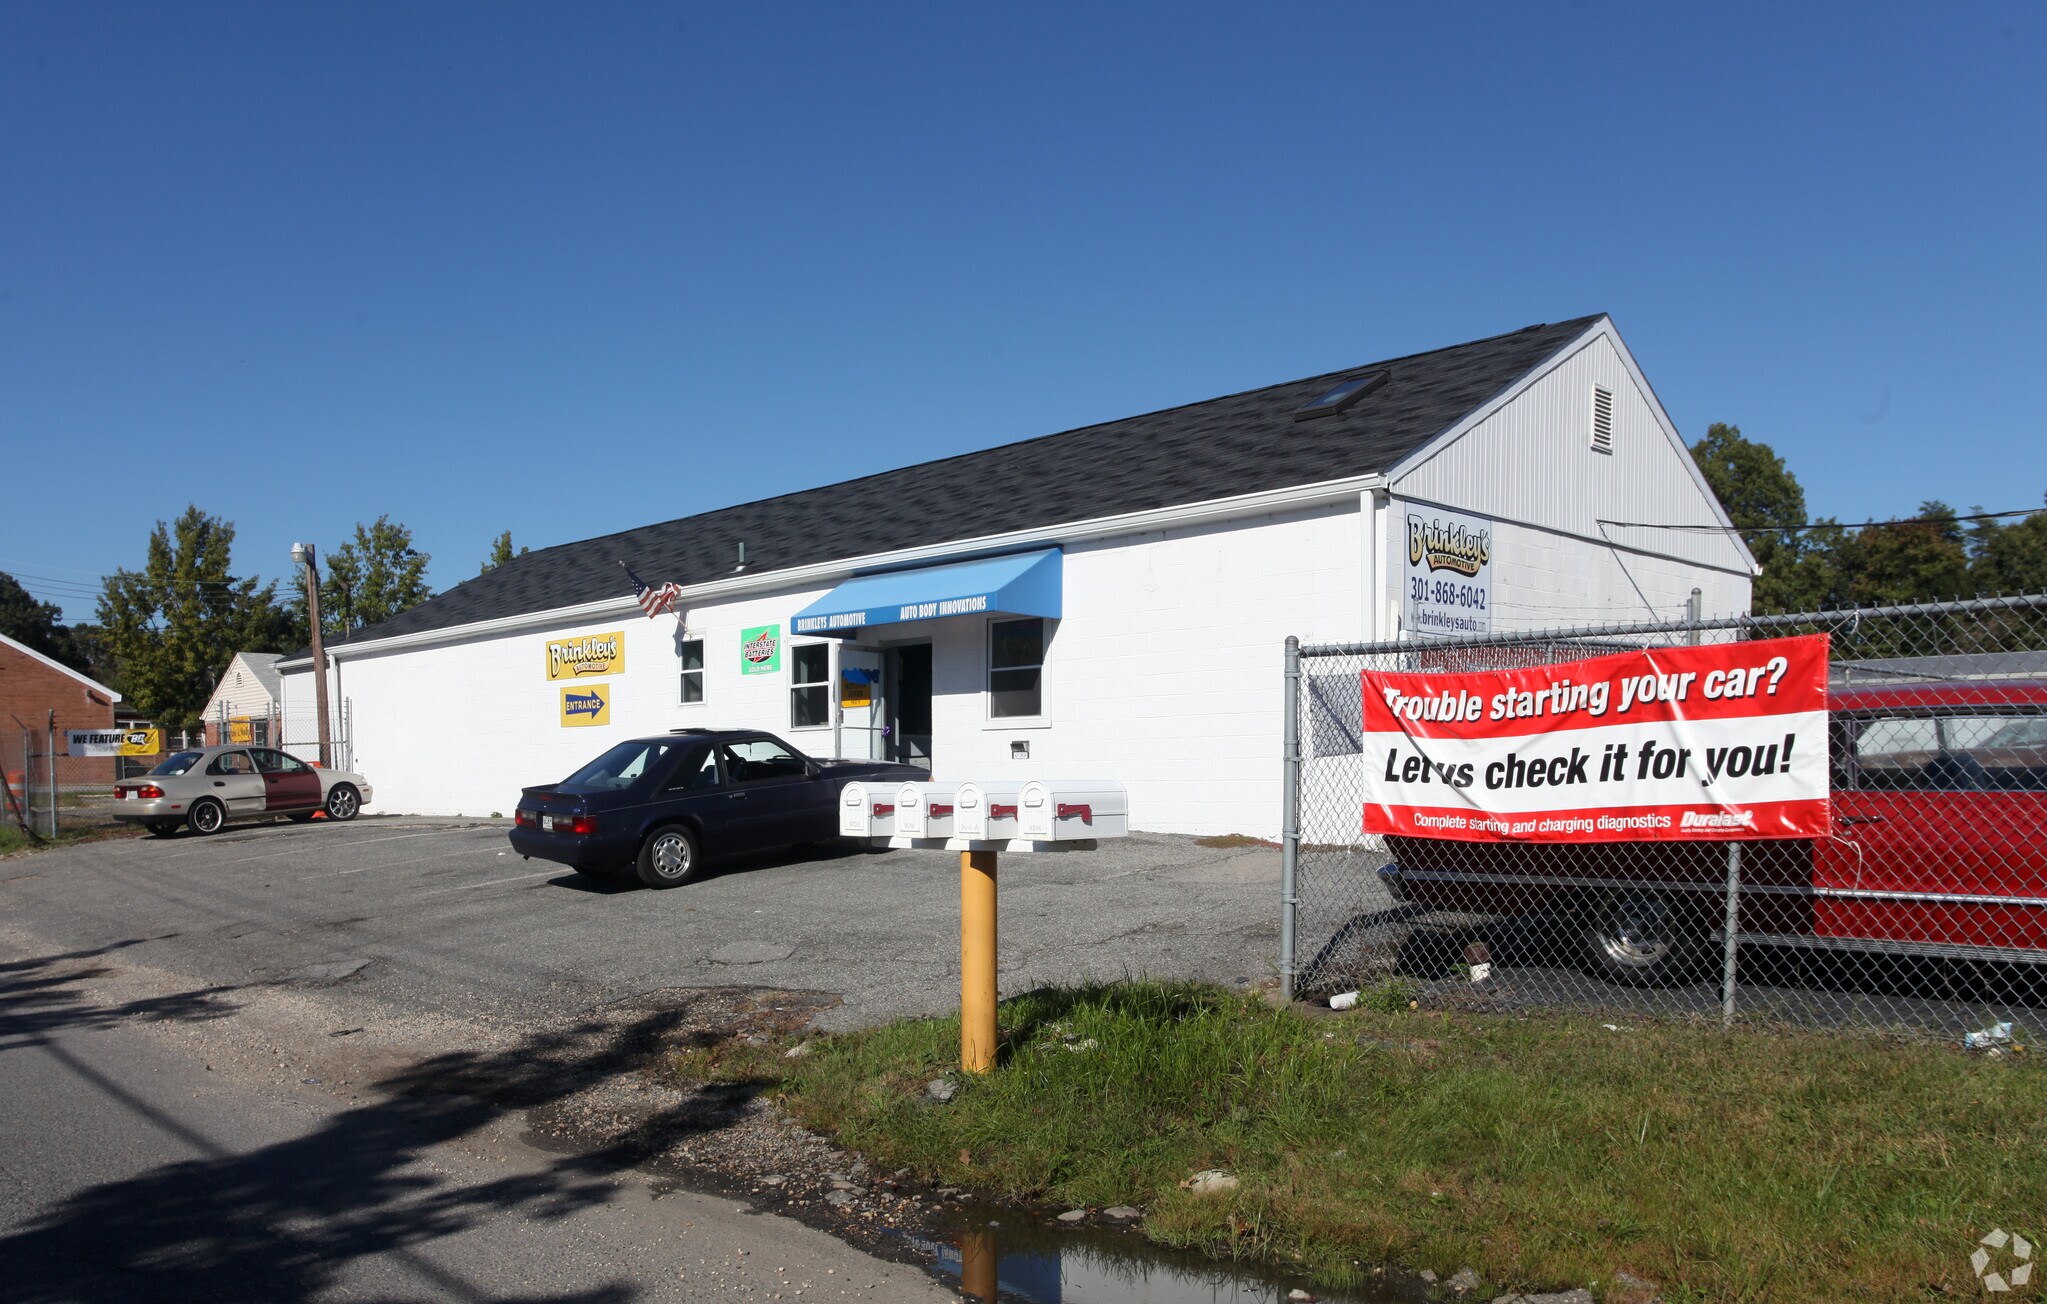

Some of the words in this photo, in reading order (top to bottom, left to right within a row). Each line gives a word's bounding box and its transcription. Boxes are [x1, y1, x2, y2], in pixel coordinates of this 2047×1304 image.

[1408, 514, 1490, 567] Brinkley's
[1433, 555, 1475, 571] AUTOMOTIVE
[1411, 577, 1486, 610] 301-868-6042
[900, 606, 918, 620] AUTO
[919, 602, 937, 617] BODY
[939, 595, 987, 615] INNOVATIONS
[797, 616, 827, 631] BRINKLEYS
[829, 612, 866, 628] AUTOMOTIVE
[744, 639, 776, 650] INTERSTATE
[745, 648, 774, 658] BATTERIES
[549, 635, 617, 677] Brinkley's
[576, 662, 606, 672] AUTOMOTIVE
[1384, 687, 1483, 722] Trouble
[1489, 679, 1610, 720] starting
[1617, 671, 1697, 712] your
[1703, 656, 1788, 699] car?
[566, 699, 601, 710] ENTRANCE
[73, 734, 88, 744] WE
[89, 733, 125, 744] FEATURE
[1384, 748, 1432, 784] Let
[1437, 761, 1474, 788] us
[1485, 747, 1590, 790] check
[1599, 744, 1628, 782] it
[1637, 740, 1691, 780] for
[1702, 733, 1795, 787] you!
[1414, 812, 1466, 829] Complete
[1469, 818, 1509, 835] starting
[1512, 818, 1537, 834] and
[1539, 816, 1594, 833] charging
[1597, 813, 1671, 832] diagnostics
[1680, 810, 1753, 828] Duralast
